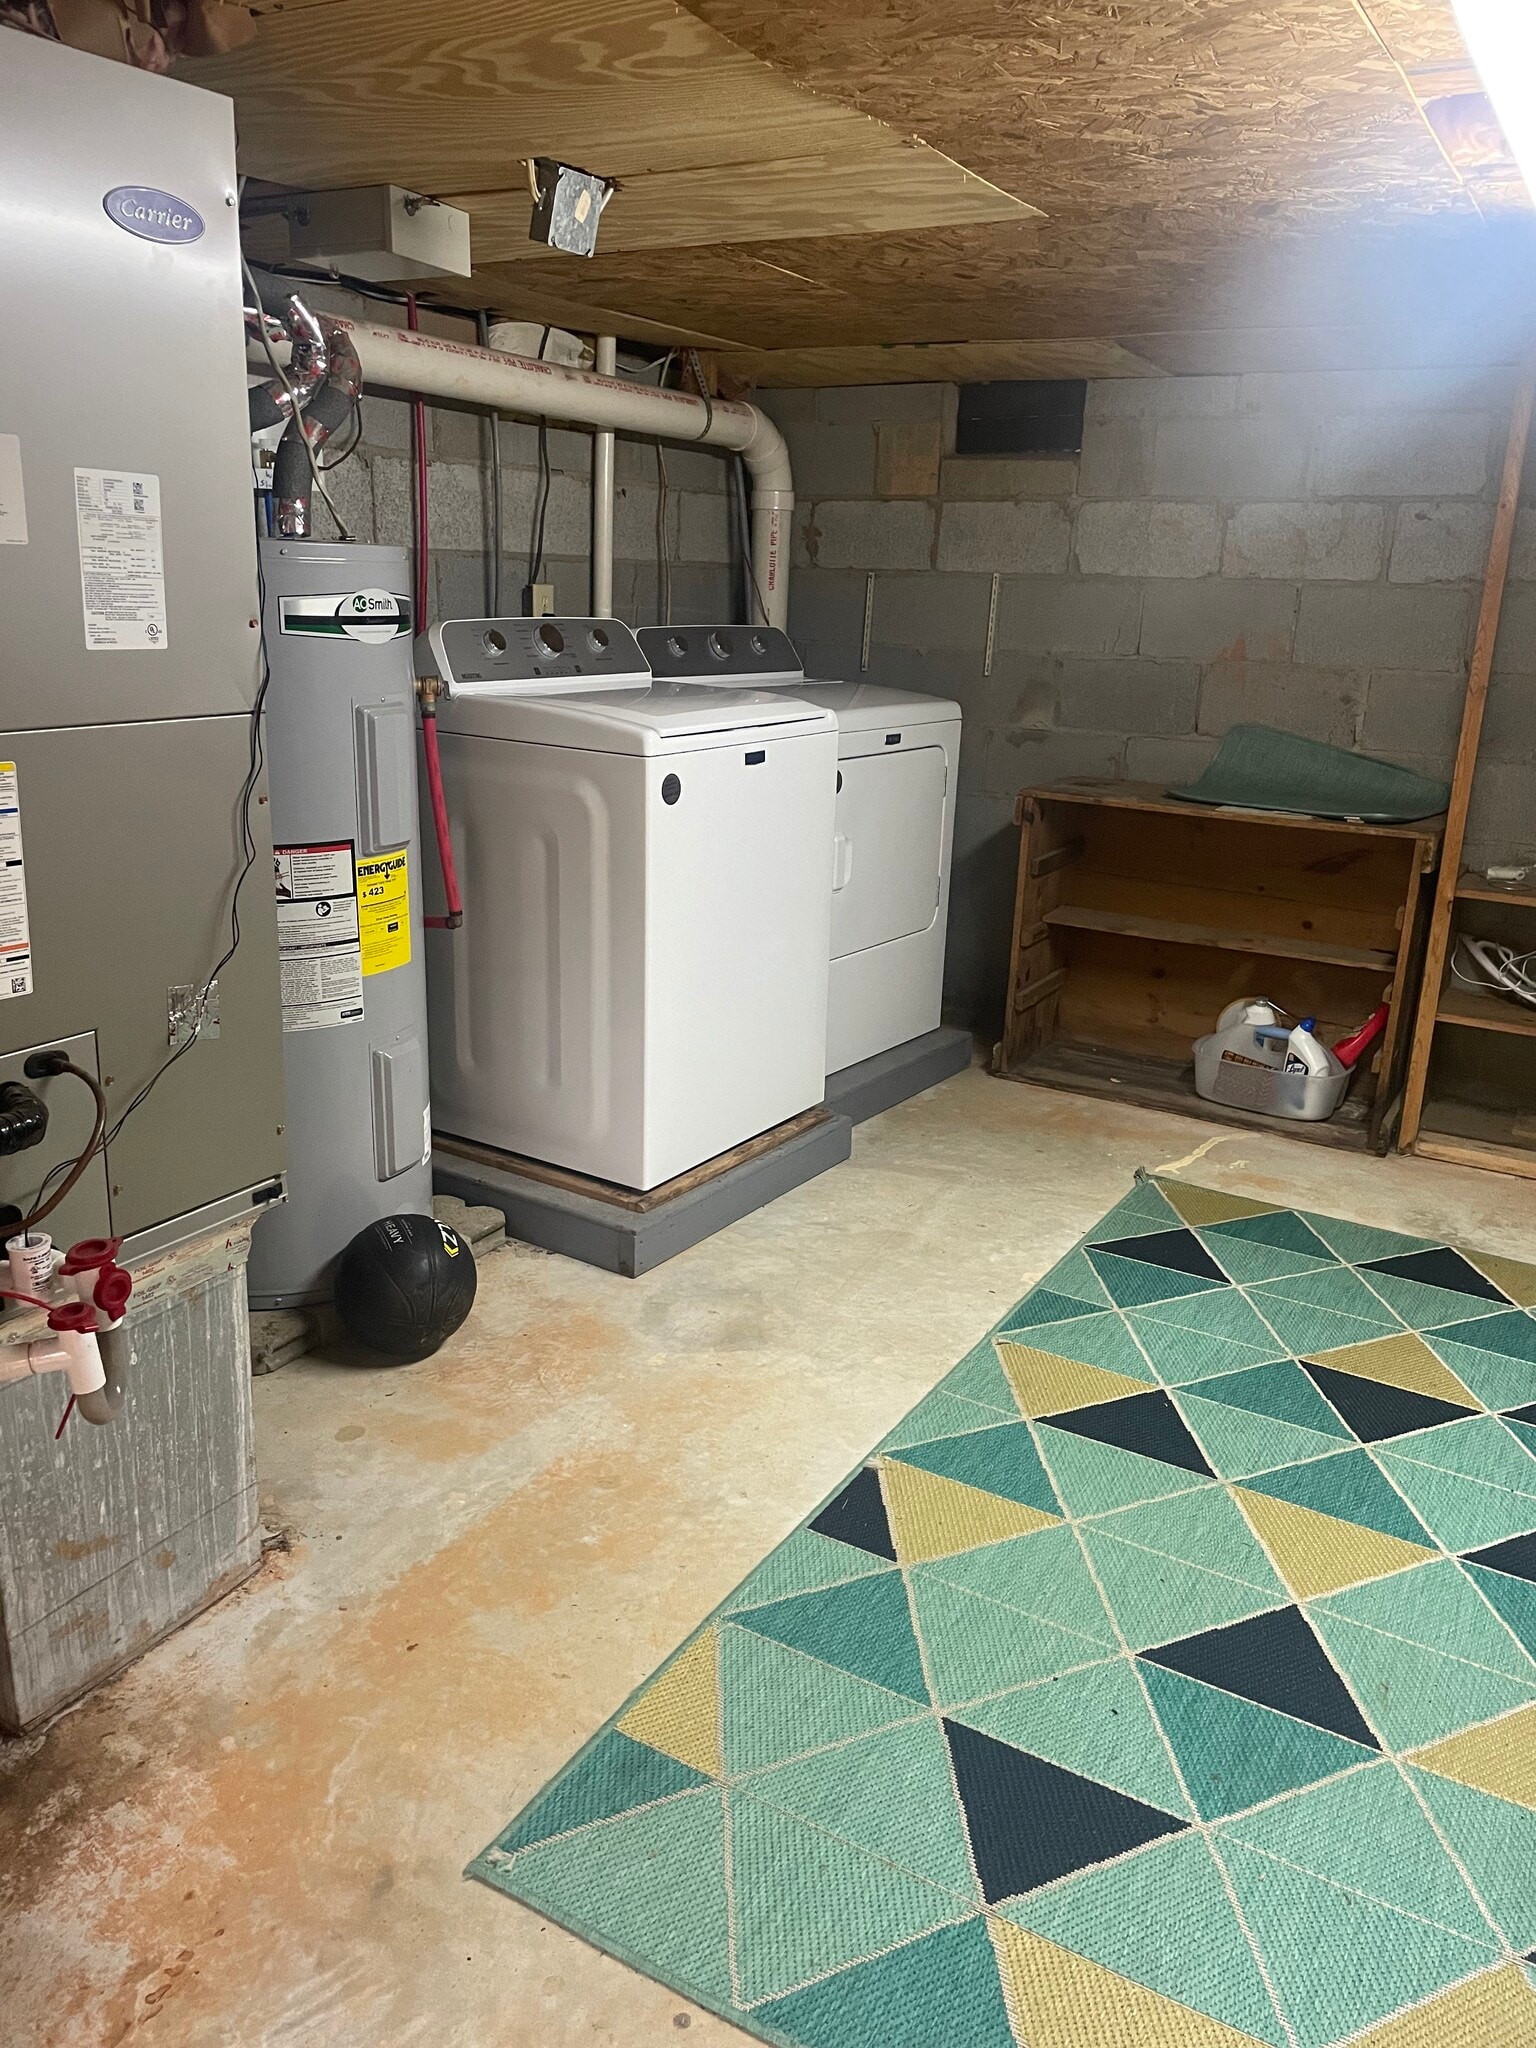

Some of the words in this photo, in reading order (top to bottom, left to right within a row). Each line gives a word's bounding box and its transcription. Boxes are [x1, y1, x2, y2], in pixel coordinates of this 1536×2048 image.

[121, 199, 192, 230] Carrier
[368, 598, 393, 610] Smith
[368, 886, 385, 896] 423
[383, 1220, 404, 1245] HEAVY
